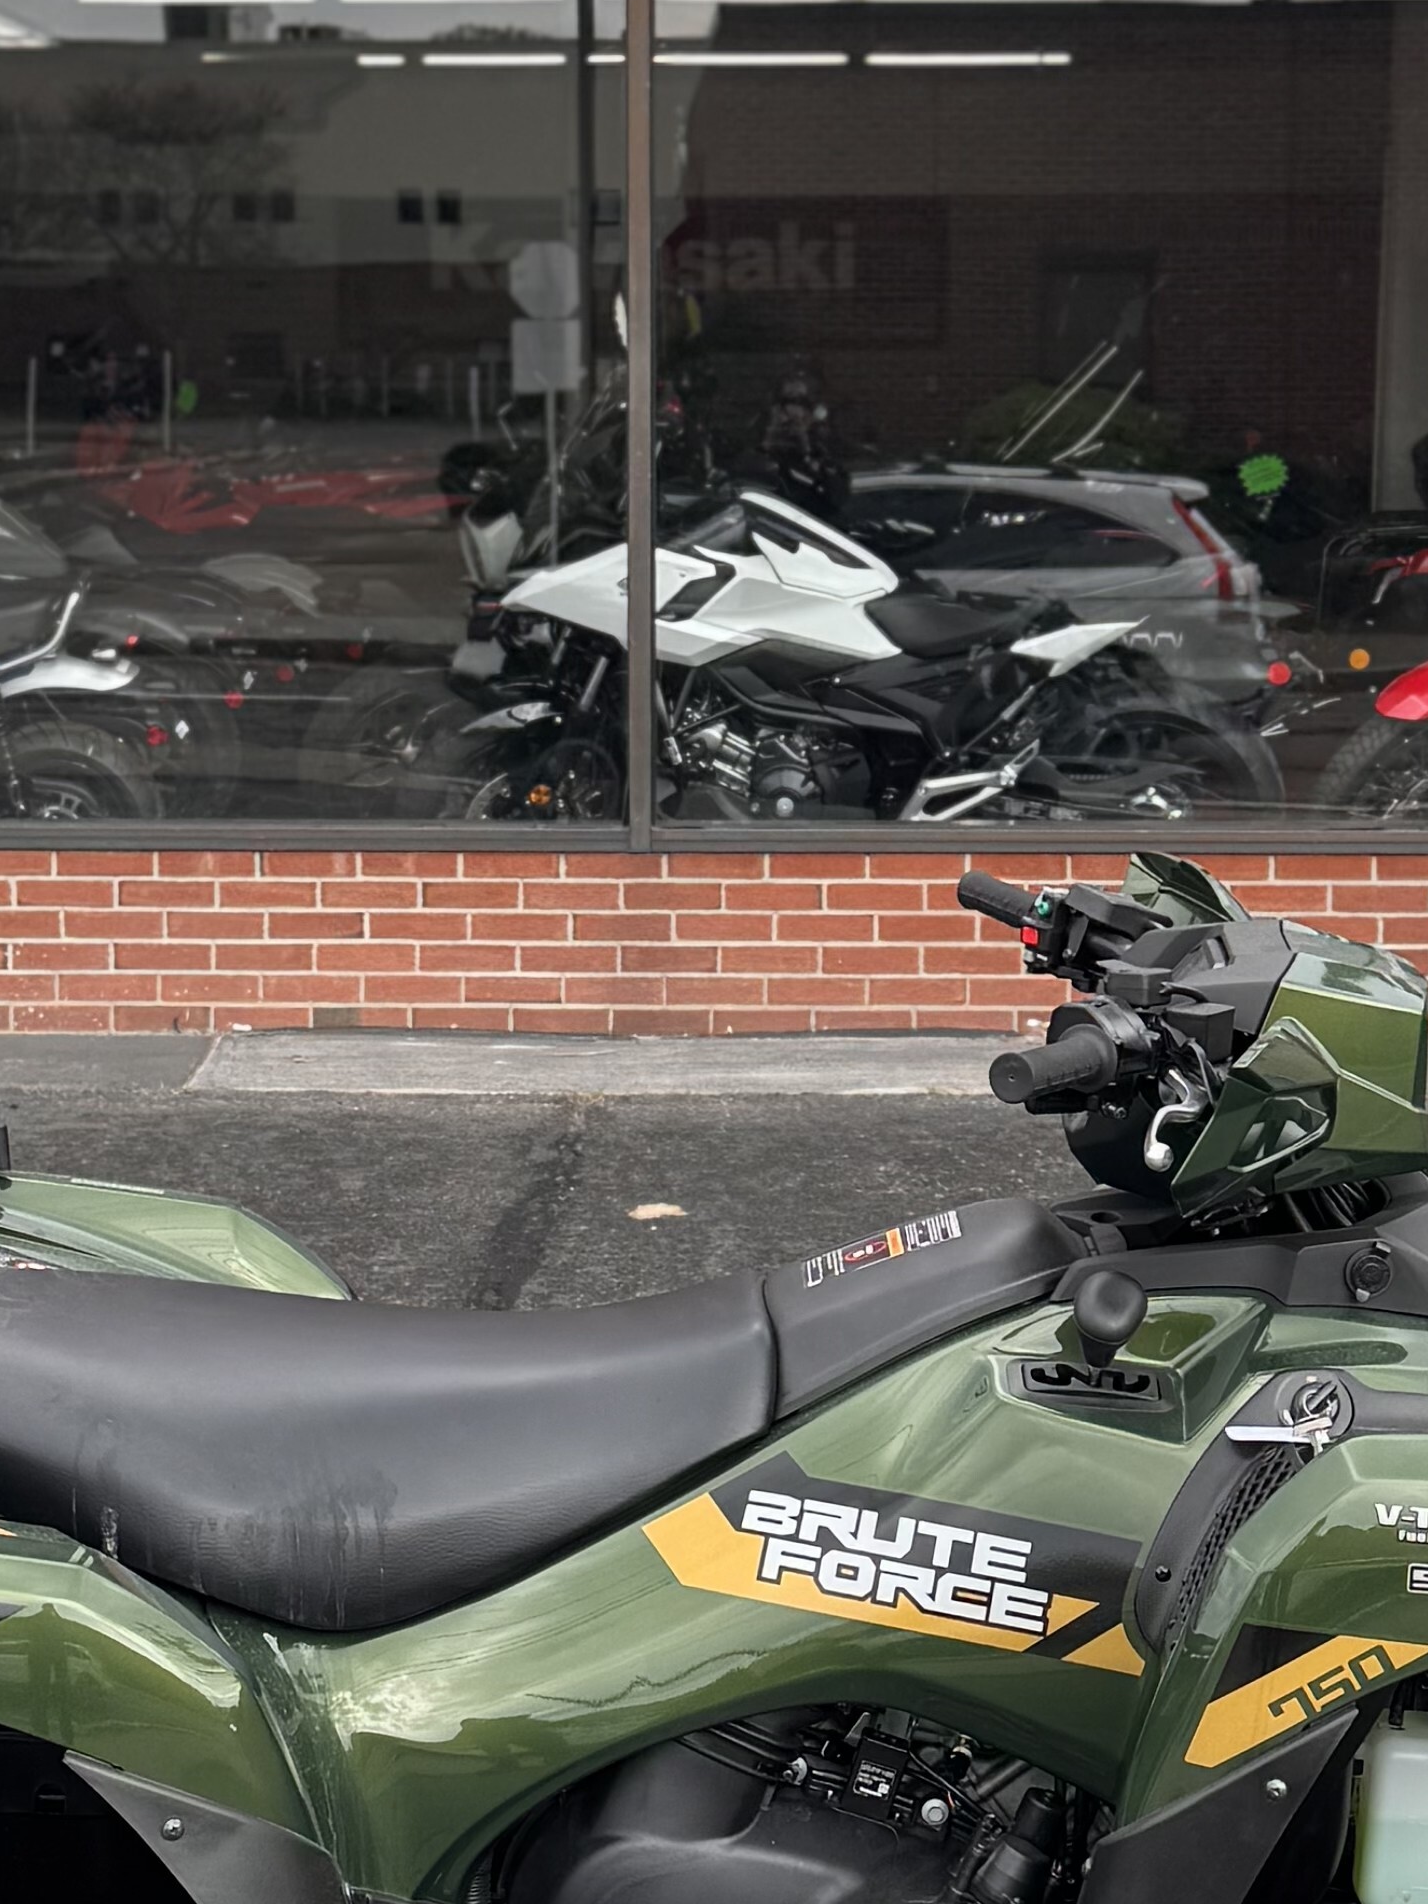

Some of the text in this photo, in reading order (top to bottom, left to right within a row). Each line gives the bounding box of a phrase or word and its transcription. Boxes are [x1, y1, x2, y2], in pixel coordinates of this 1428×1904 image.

[740, 1489, 1033, 1584] BRUTE
[759, 1535, 1050, 1633] FORCE
[1268, 1644, 1398, 1722] 750
